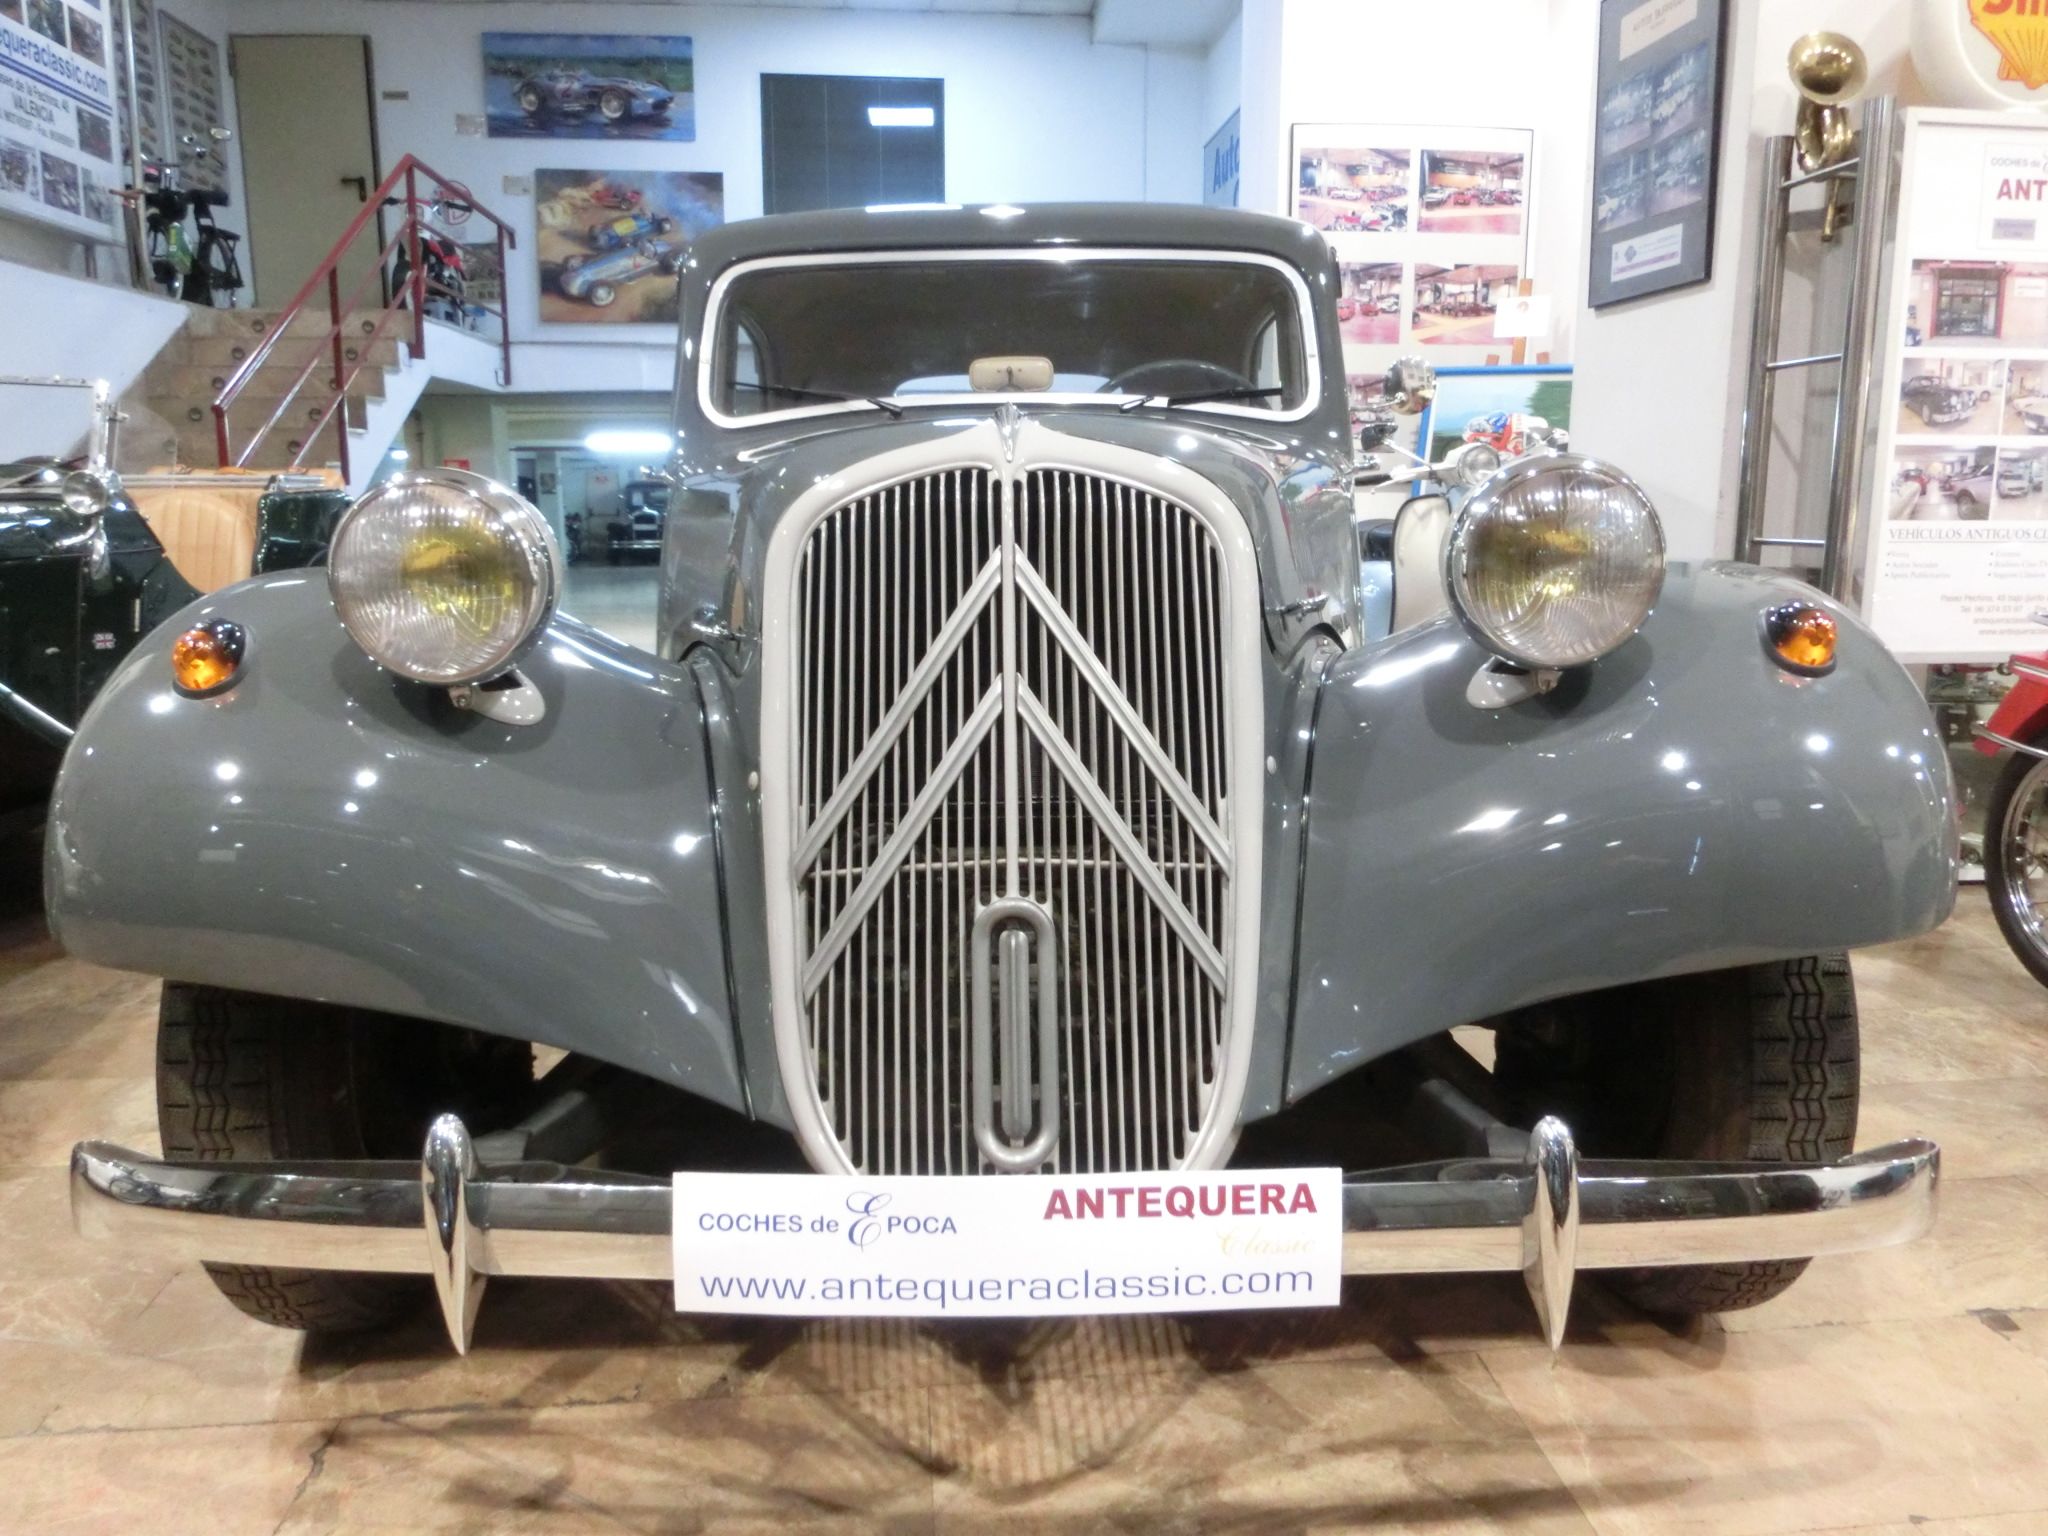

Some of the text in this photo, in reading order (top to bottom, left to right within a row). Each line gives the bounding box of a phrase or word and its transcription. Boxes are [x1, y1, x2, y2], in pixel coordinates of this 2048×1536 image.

[1967, 528, 2031, 540] ANTIGUOS
[1043, 1183, 1318, 1220] ANTEQUERA
[699, 1213, 803, 1233] COCHES
[811, 1215, 839, 1233] de
[1216, 1224, 1316, 1260] Classic
[700, 1267, 1313, 1309] www.antequeraclassic.com
